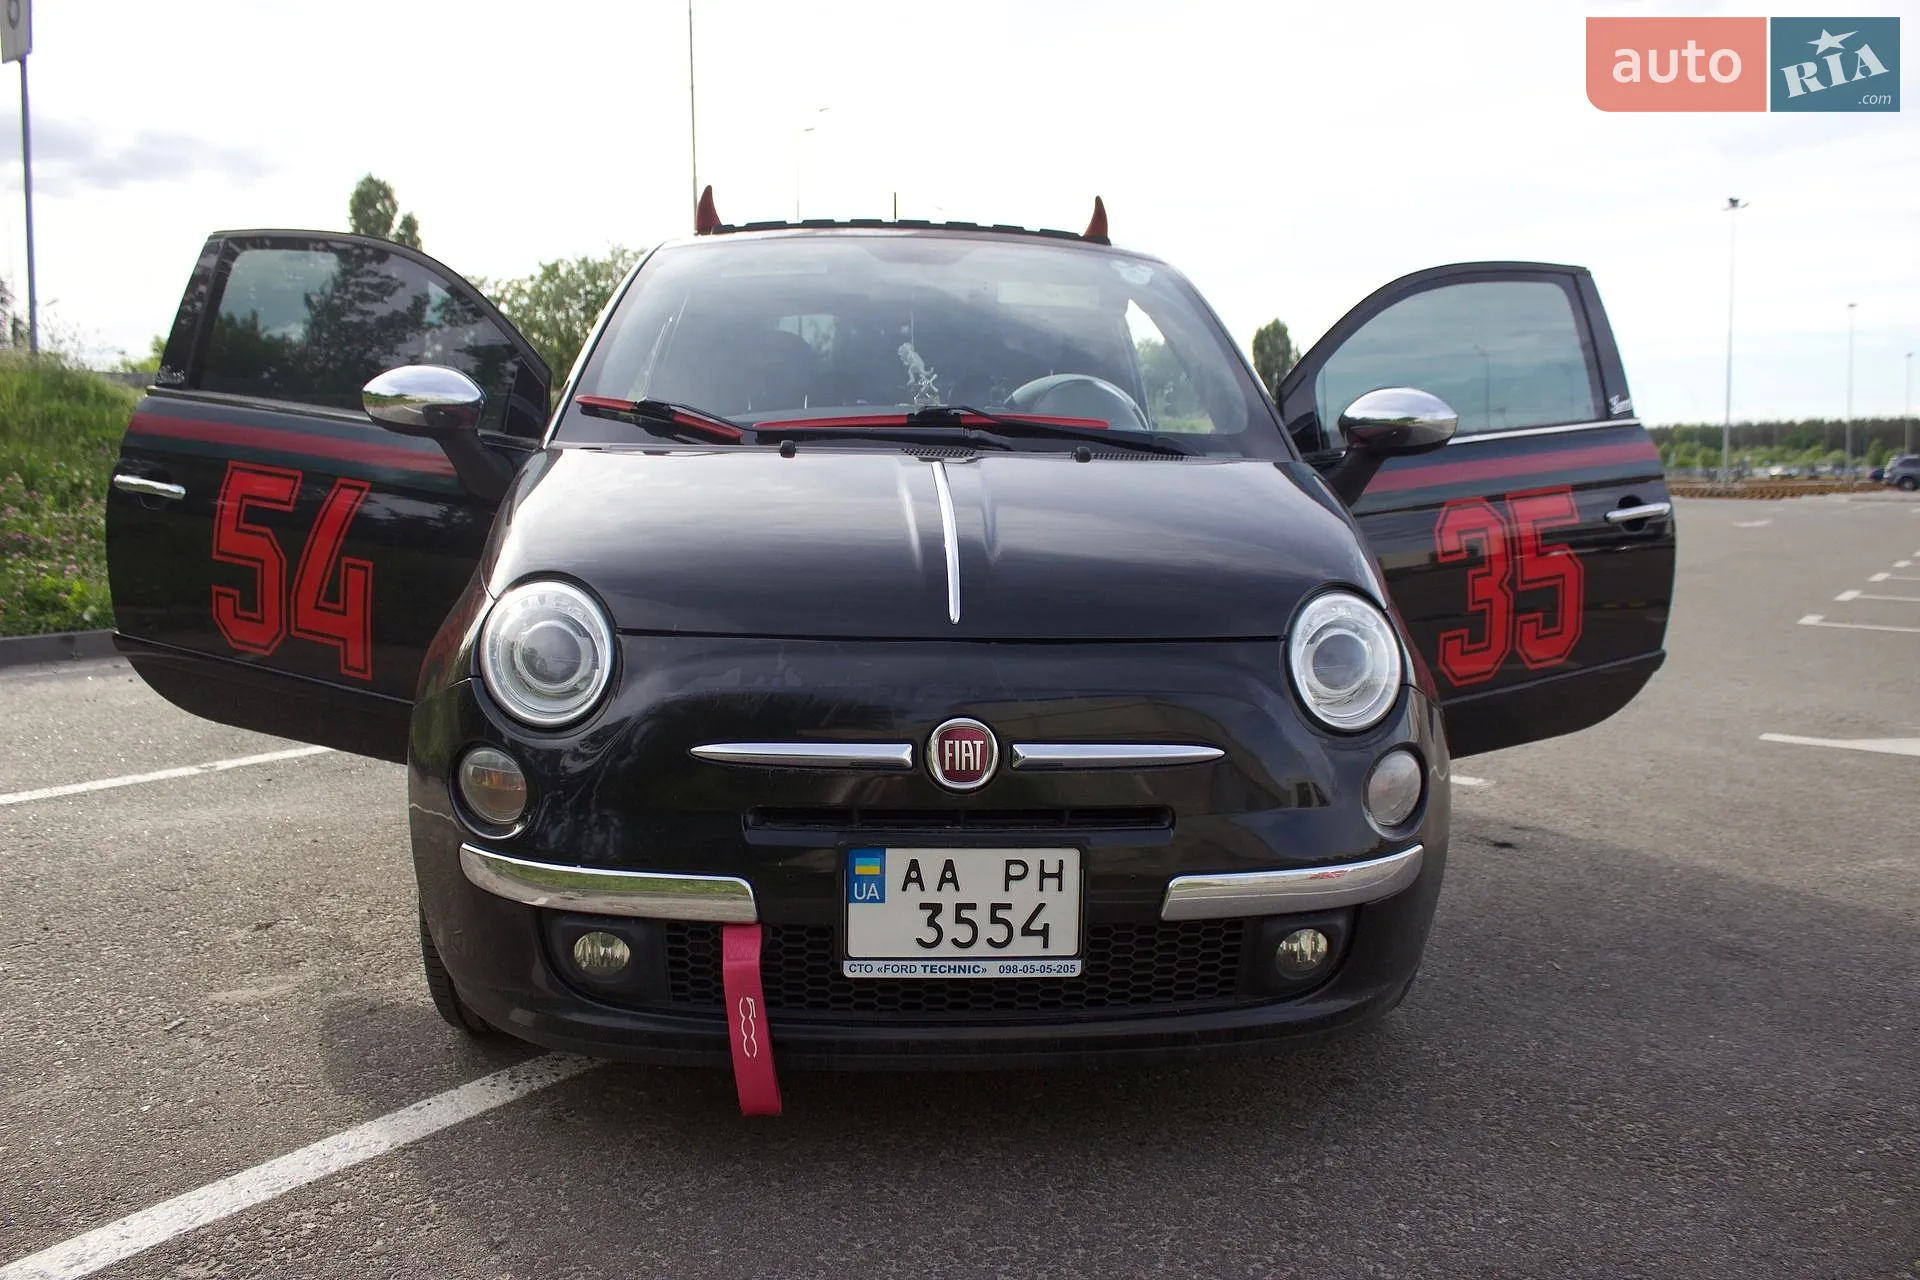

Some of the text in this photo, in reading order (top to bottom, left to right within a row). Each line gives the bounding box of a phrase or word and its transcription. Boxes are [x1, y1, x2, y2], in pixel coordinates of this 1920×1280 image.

[211, 460, 373, 680] 54
[1434, 485, 1584, 687] 35
[944, 739, 985, 771] FIAT
[853, 883, 880, 900] UA
[901, 858, 961, 892] AA
[915, 902, 1050, 949] 3554
[998, 964, 1076, 974] 098-05-05-205
